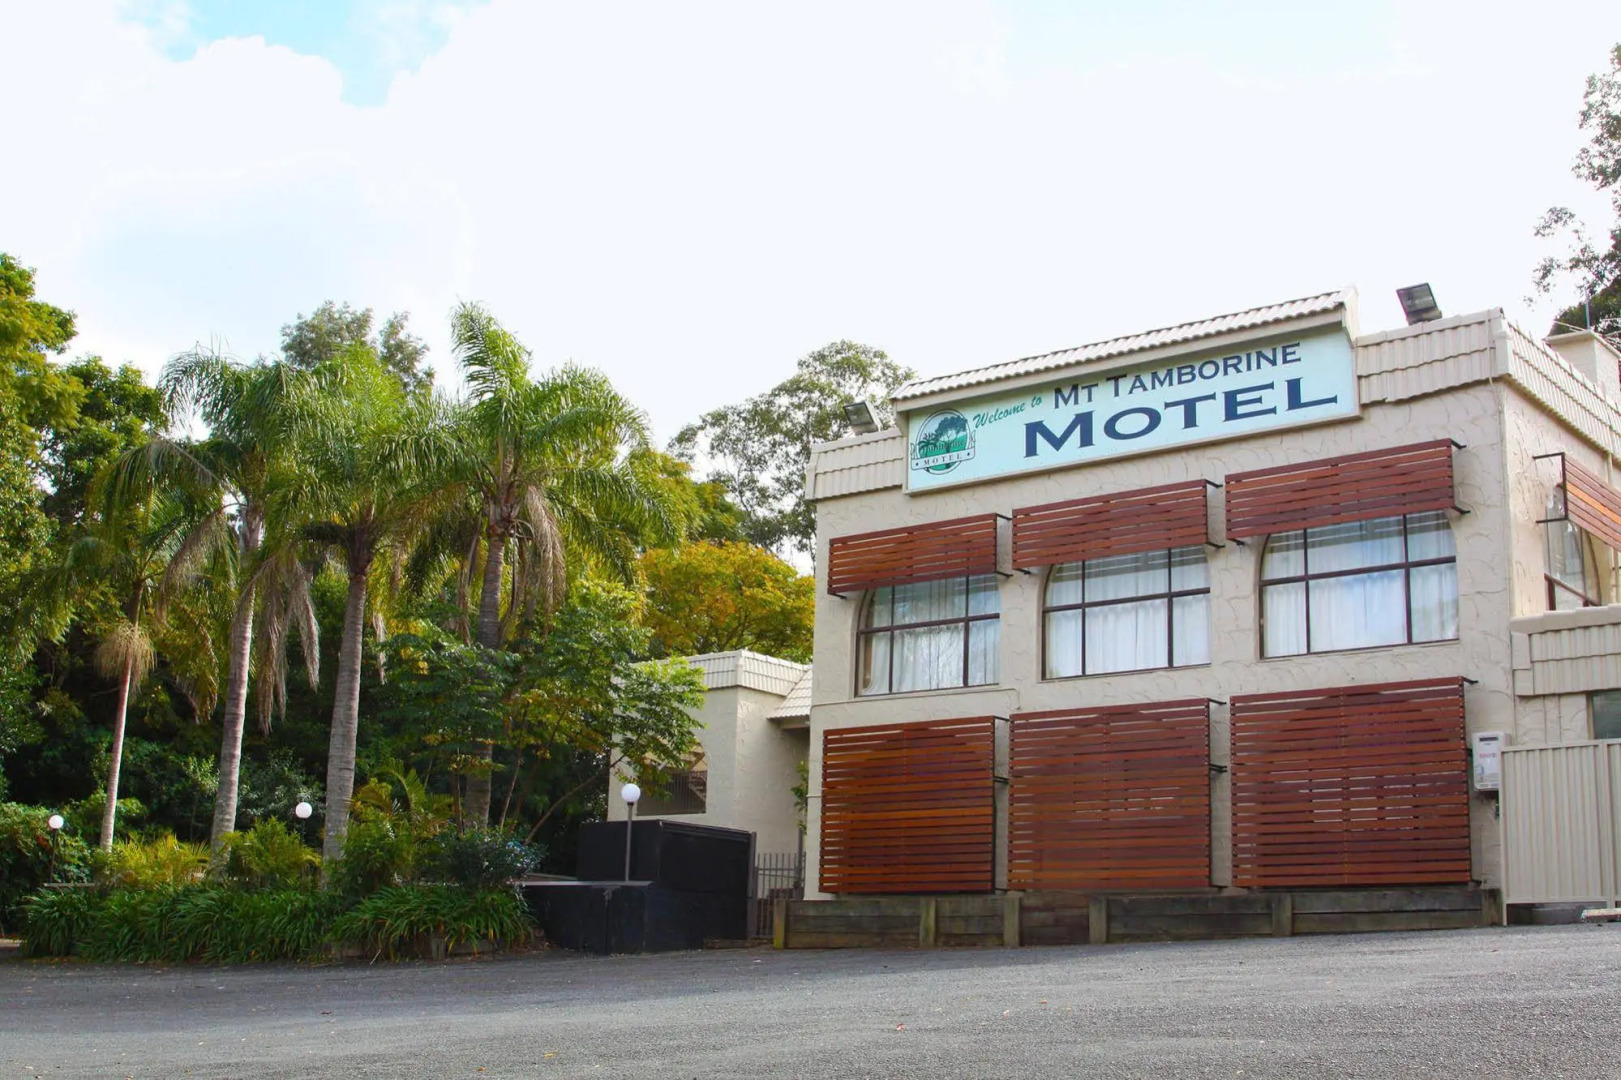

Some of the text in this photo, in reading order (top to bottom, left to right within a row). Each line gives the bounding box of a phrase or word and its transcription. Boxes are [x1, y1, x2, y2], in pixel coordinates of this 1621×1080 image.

[972, 402, 1026, 430] Welcome
[1030, 394, 1043, 409] to
[1106, 342, 1302, 398] TAMBORINE
[1023, 376, 1338, 459] MOTEL
[923, 453, 963, 466] MOTEL
